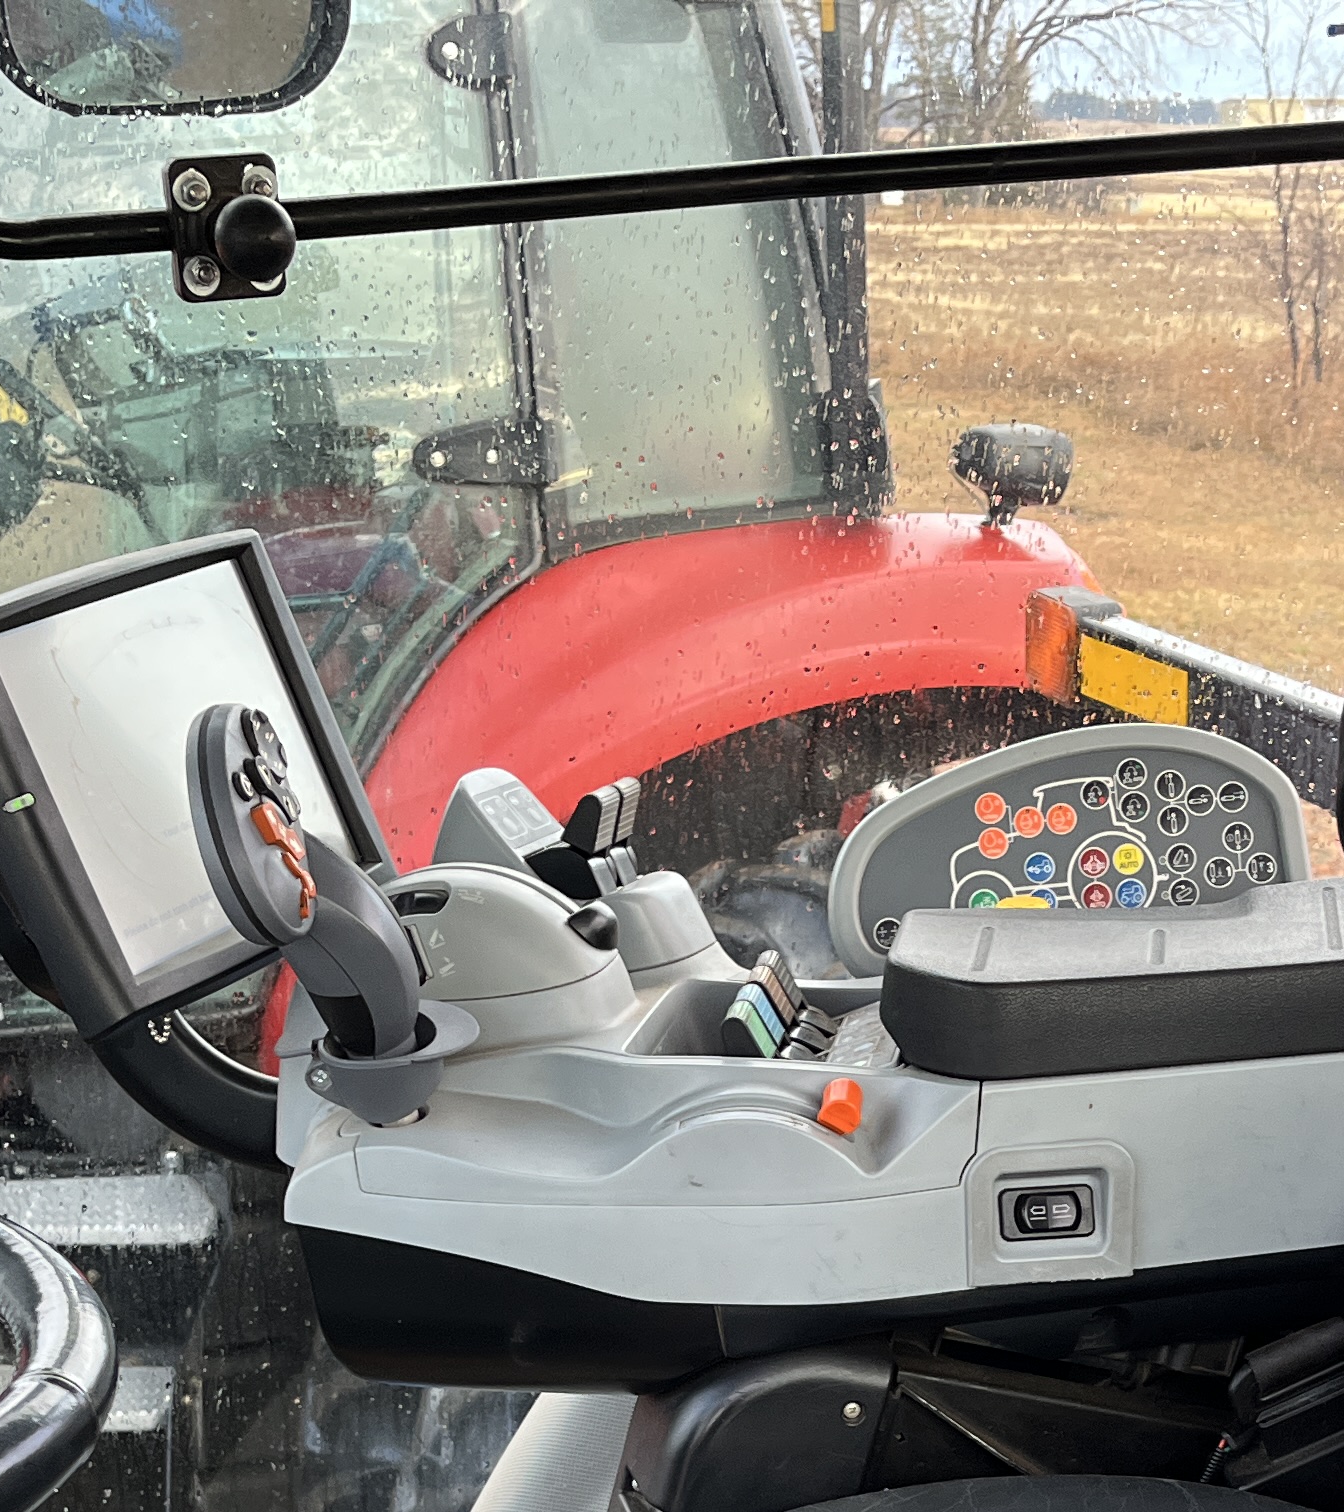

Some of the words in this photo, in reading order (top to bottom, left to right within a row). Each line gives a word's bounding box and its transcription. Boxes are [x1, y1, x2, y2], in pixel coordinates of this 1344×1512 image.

[1119, 860, 1139, 869] AUTO
[1266, 861, 1274, 873] 3
[1225, 865, 1232, 877] 1
